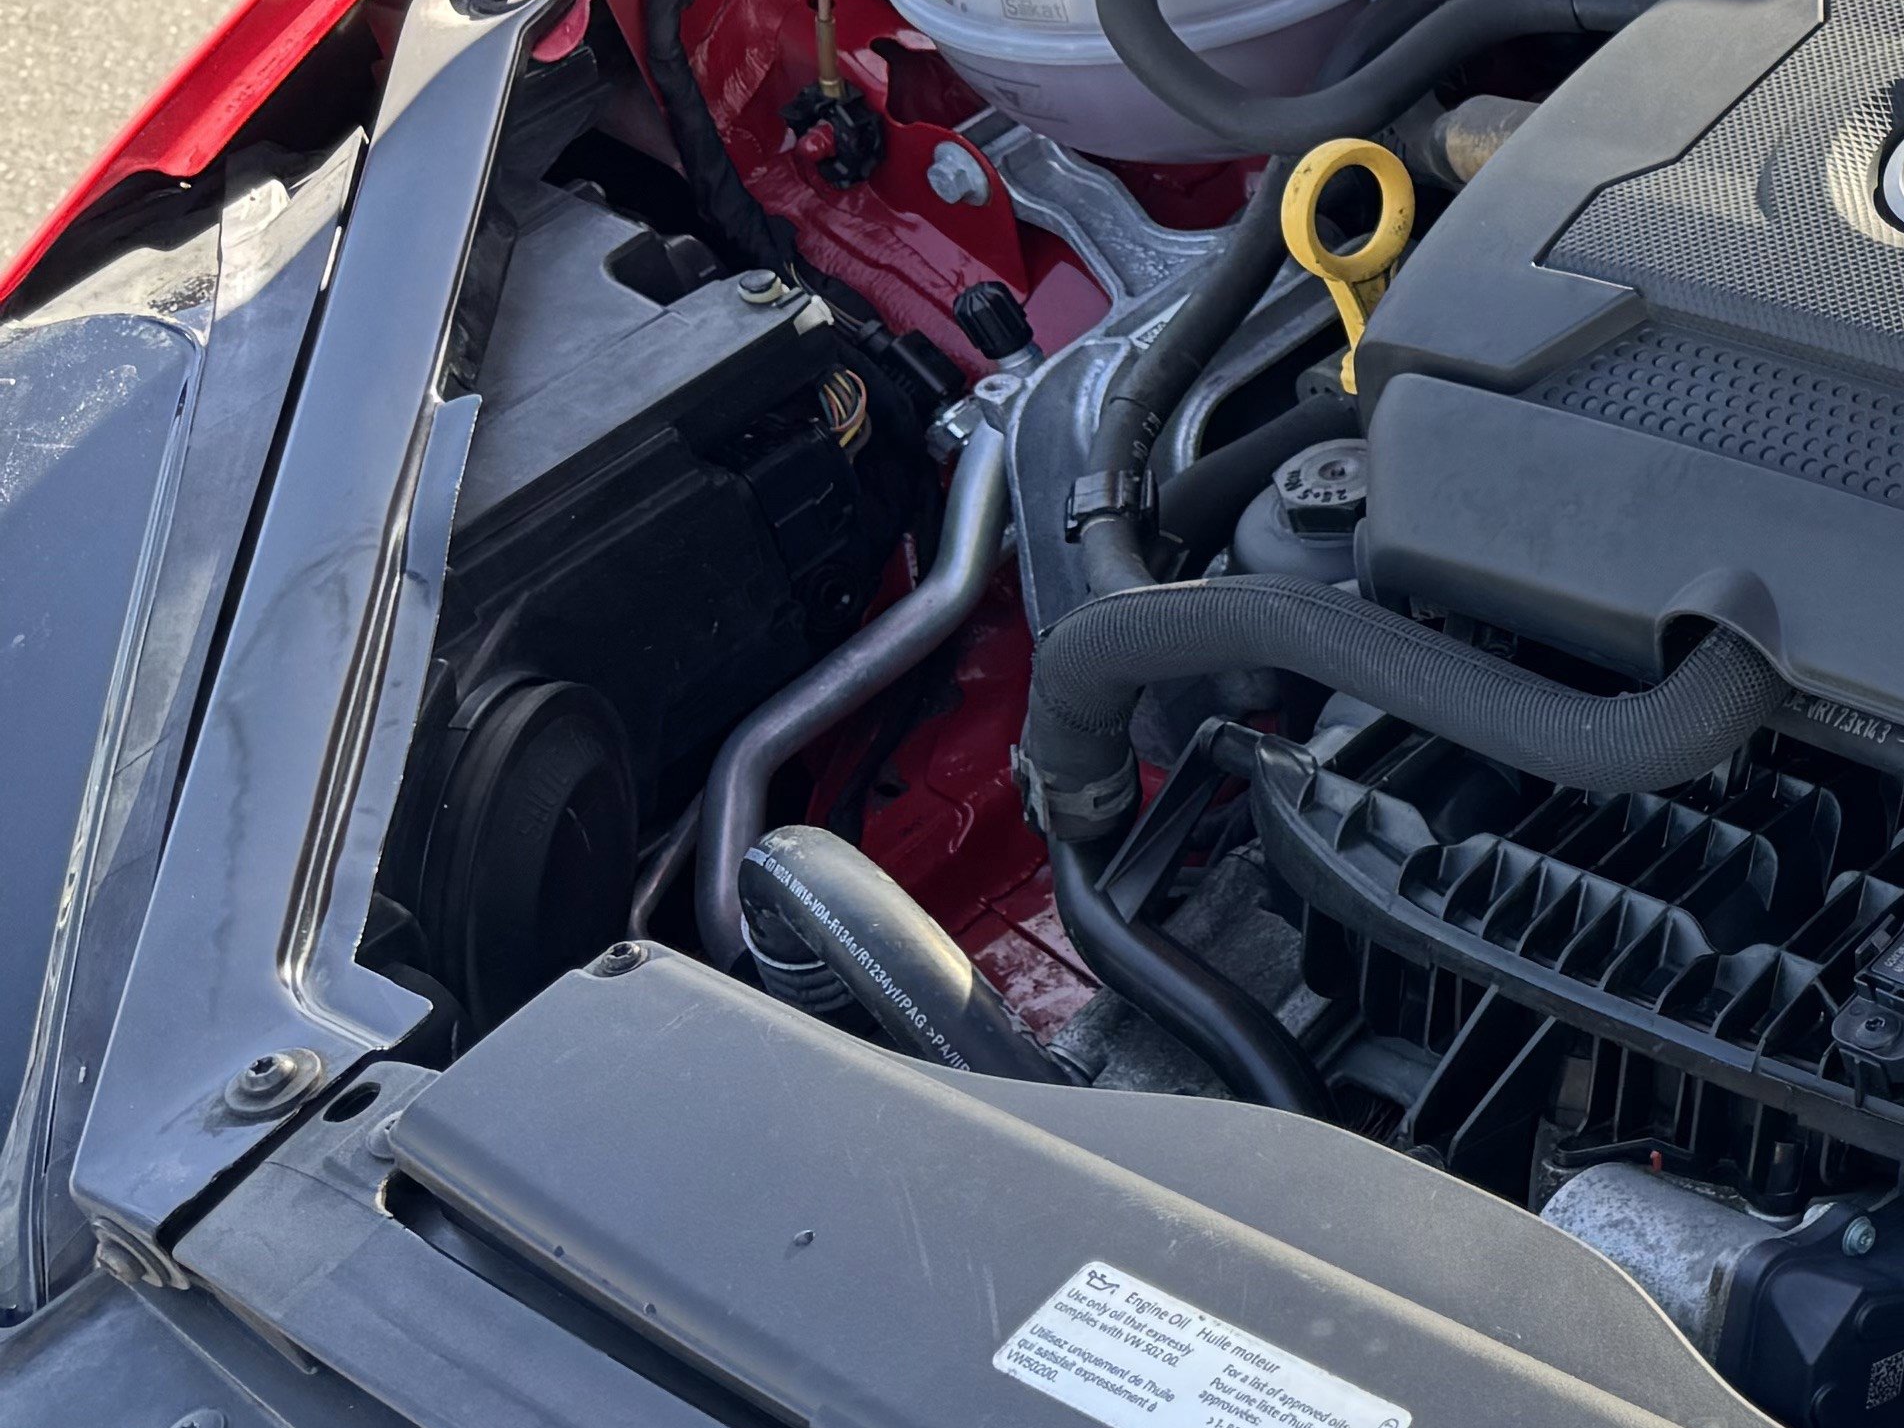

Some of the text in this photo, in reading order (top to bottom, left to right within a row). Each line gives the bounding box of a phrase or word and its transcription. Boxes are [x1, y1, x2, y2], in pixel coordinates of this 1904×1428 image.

[1016, 1336, 1039, 1352] qui
[1052, 1300, 1100, 1328] complies
[1097, 1321, 1124, 1340] with
[1122, 1331, 1146, 1349] VW
[1140, 1341, 1165, 1359] 502
[1065, 1286, 1195, 1357] Use only oil that expressly
[1123, 1290, 1281, 1374] Engine Oil Huile moteur
[1126, 1373, 1144, 1387] de
[1208, 1375, 1237, 1396] Pour
[1233, 1390, 1257, 1407] une
[1254, 1398, 1281, 1419] liste
[1221, 1362, 1243, 1379] For
[1247, 1375, 1269, 1393] list
[1277, 1392, 1332, 1423] approved
